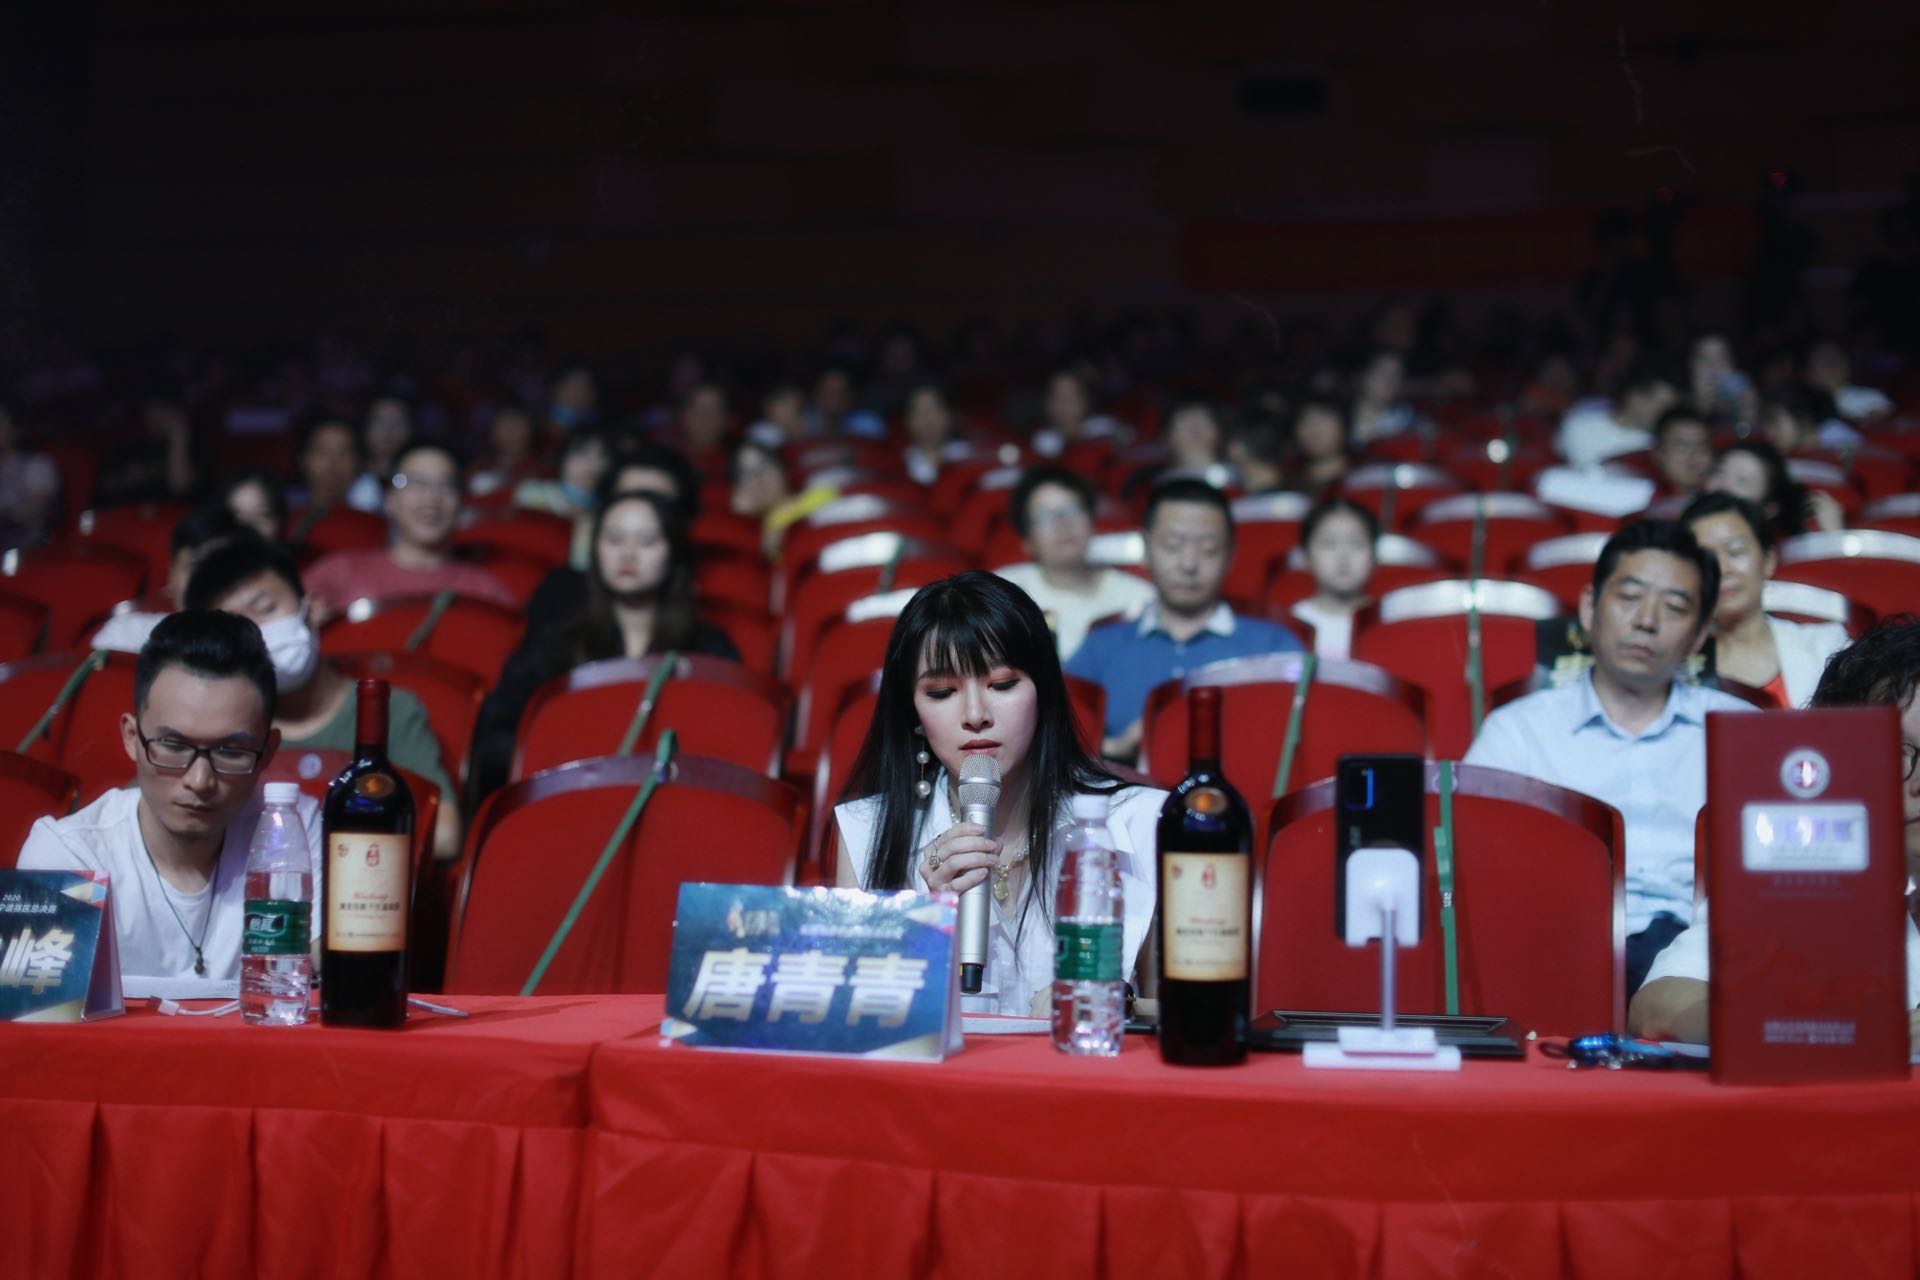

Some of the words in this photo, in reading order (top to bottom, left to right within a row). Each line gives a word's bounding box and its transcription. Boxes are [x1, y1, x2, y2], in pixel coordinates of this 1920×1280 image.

[0, 926, 75, 995] 峰
[682, 947, 928, 1028] 唐青青
